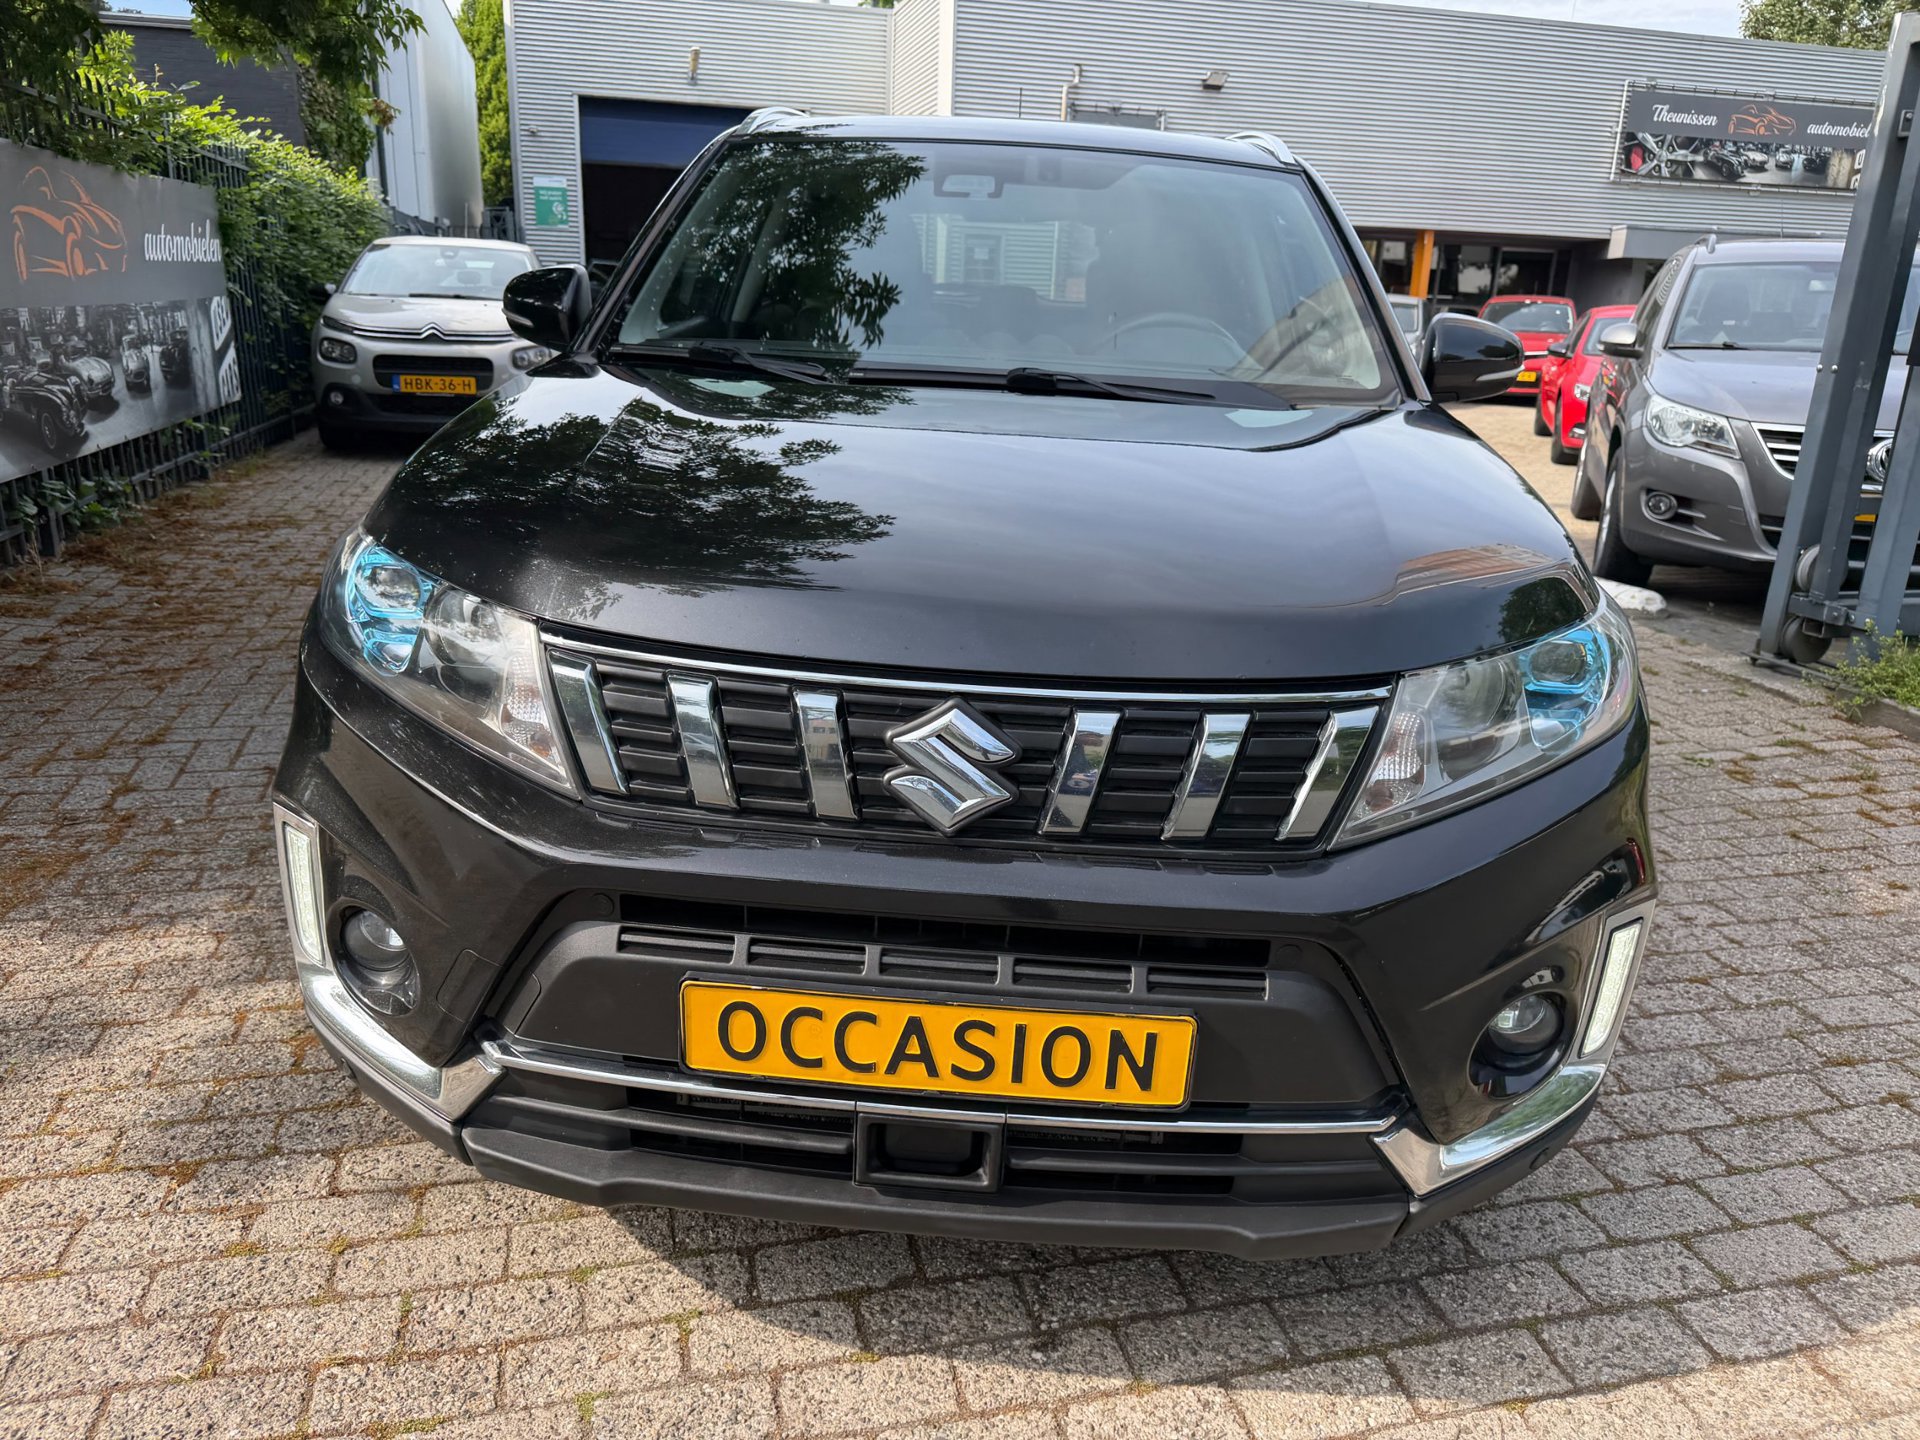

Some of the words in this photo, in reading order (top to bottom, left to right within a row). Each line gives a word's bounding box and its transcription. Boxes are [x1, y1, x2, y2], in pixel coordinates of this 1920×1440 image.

[1652, 104, 1718, 126] Theunissen
[1807, 121, 1872, 138] automobiel
[144, 219, 222, 262] automobielen
[404, 377, 472, 391] HBK-36-H
[717, 1000, 1159, 1092] OCCASION
